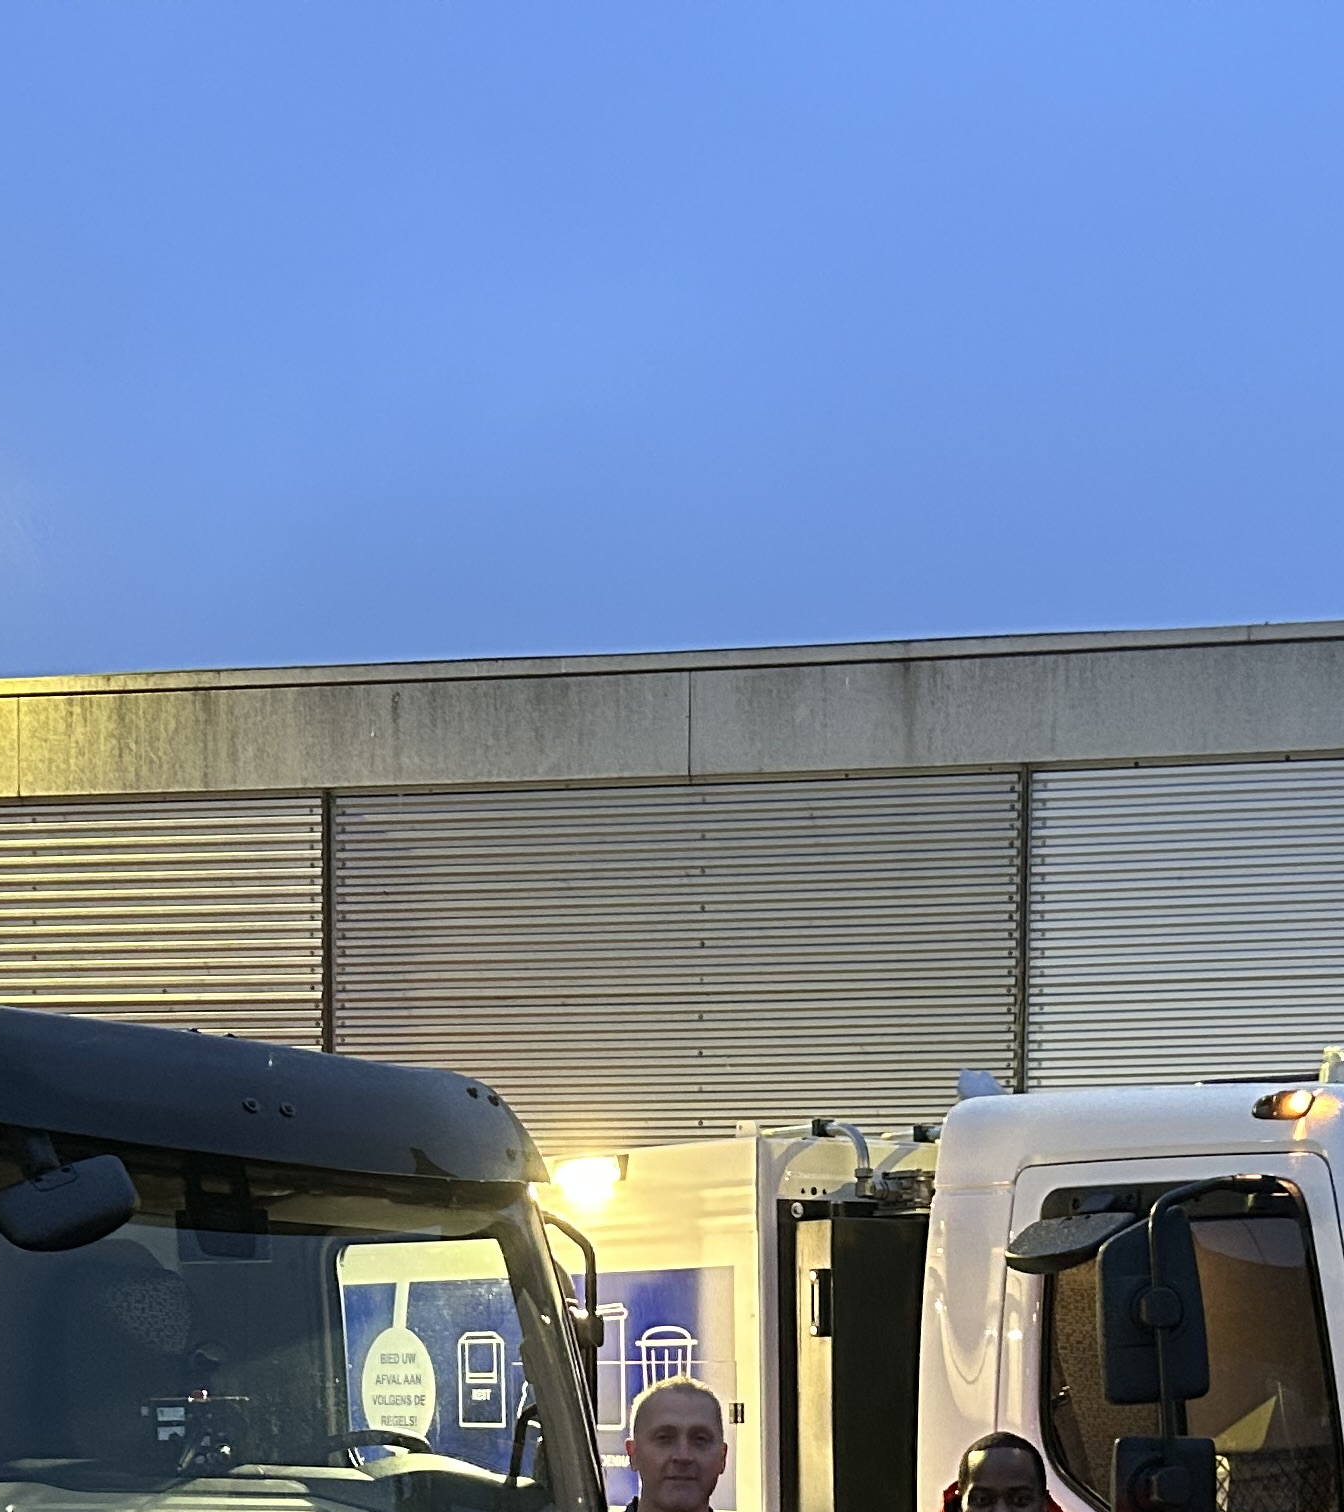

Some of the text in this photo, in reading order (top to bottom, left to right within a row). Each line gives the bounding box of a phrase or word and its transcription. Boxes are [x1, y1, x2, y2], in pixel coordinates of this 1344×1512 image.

[380, 1353, 416, 1365] BIED UW
[375, 1374, 422, 1386] AFVAL AAN
[372, 1394, 426, 1406] VOLGENS DE
[381, 1415, 418, 1427] REGELS!
